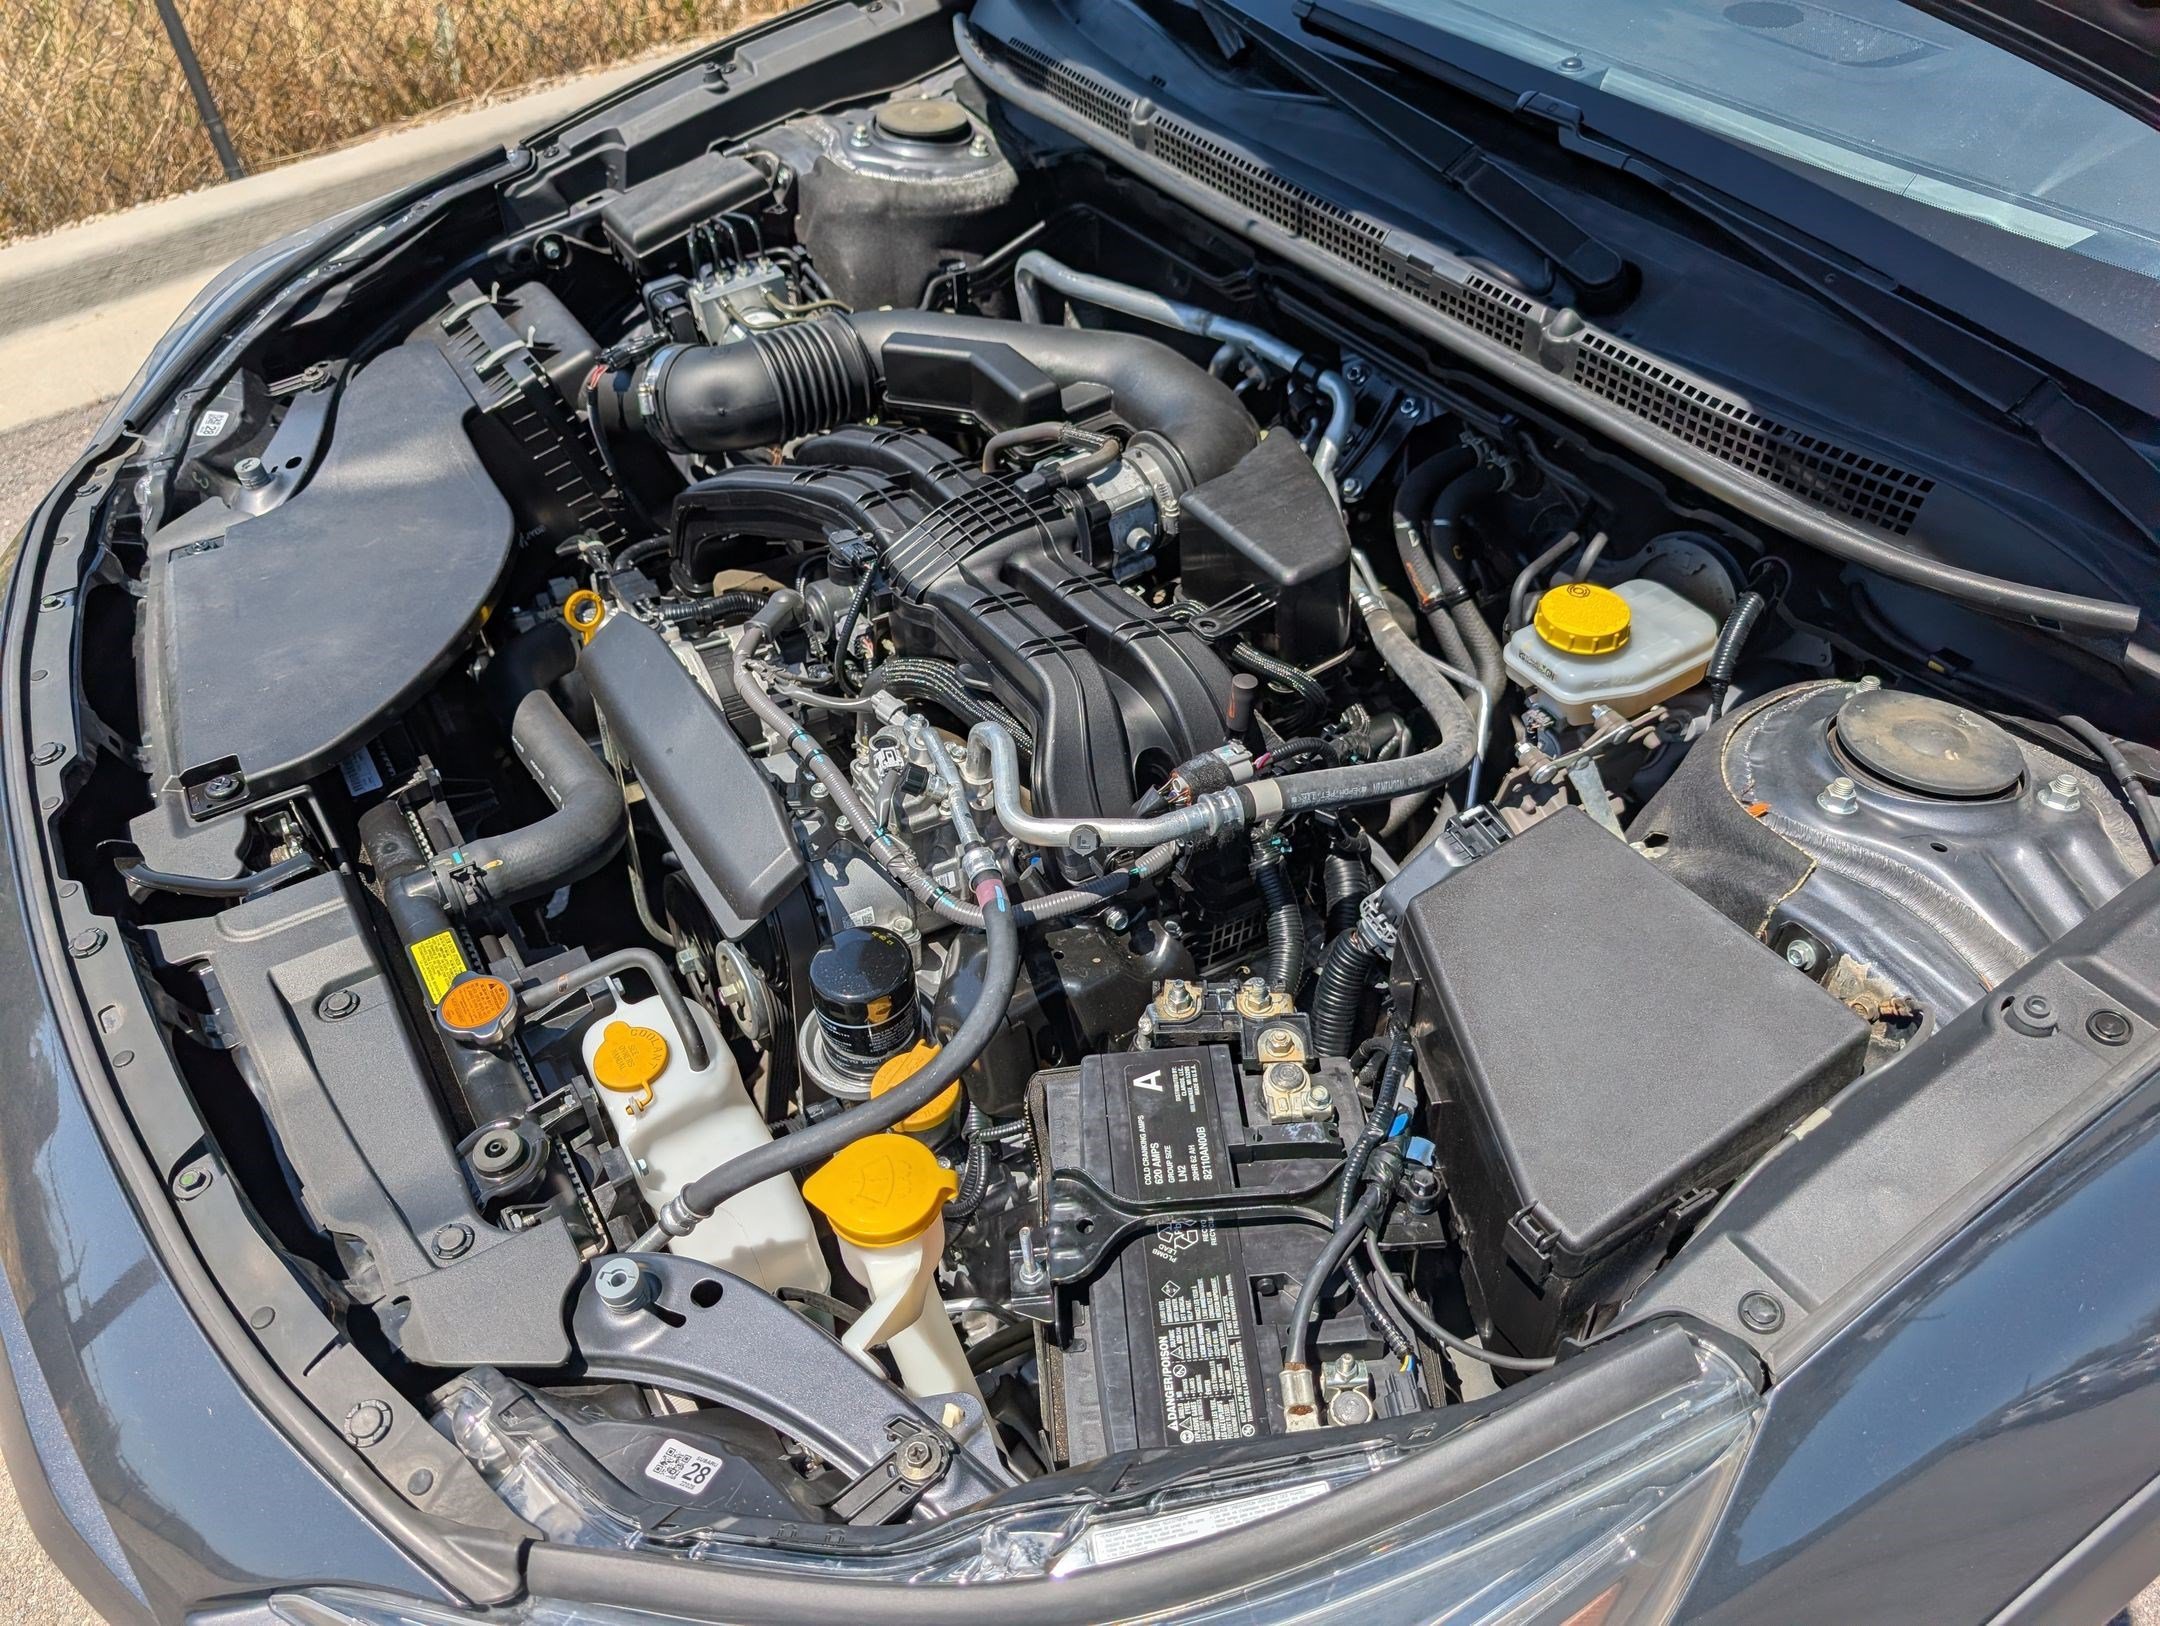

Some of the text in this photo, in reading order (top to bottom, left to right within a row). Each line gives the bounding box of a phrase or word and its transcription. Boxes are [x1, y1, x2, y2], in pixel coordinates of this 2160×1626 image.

[1132, 1069, 1163, 1091] A
[1136, 1114, 1152, 1185] COLD CRANKING AMPS
[1195, 1125, 1212, 1180] 82110AN00B
[1149, 1141, 1163, 1184] 620 AMPS
[1163, 1144, 1175, 1183] GROUP SIZE
[1176, 1164, 1187, 1182] LN2
[1188, 1144, 1199, 1181] 20HR 62 AH
[1151, 1247, 1177, 1263] PLOMB
[1157, 1242, 1177, 1255] LEAD
[1158, 1335, 1177, 1420] DANGER/POISON
[1233, 1371, 1241, 1386] REACH
[695, 1455, 718, 1467] SUBARU
[681, 1462, 711, 1484] 28
